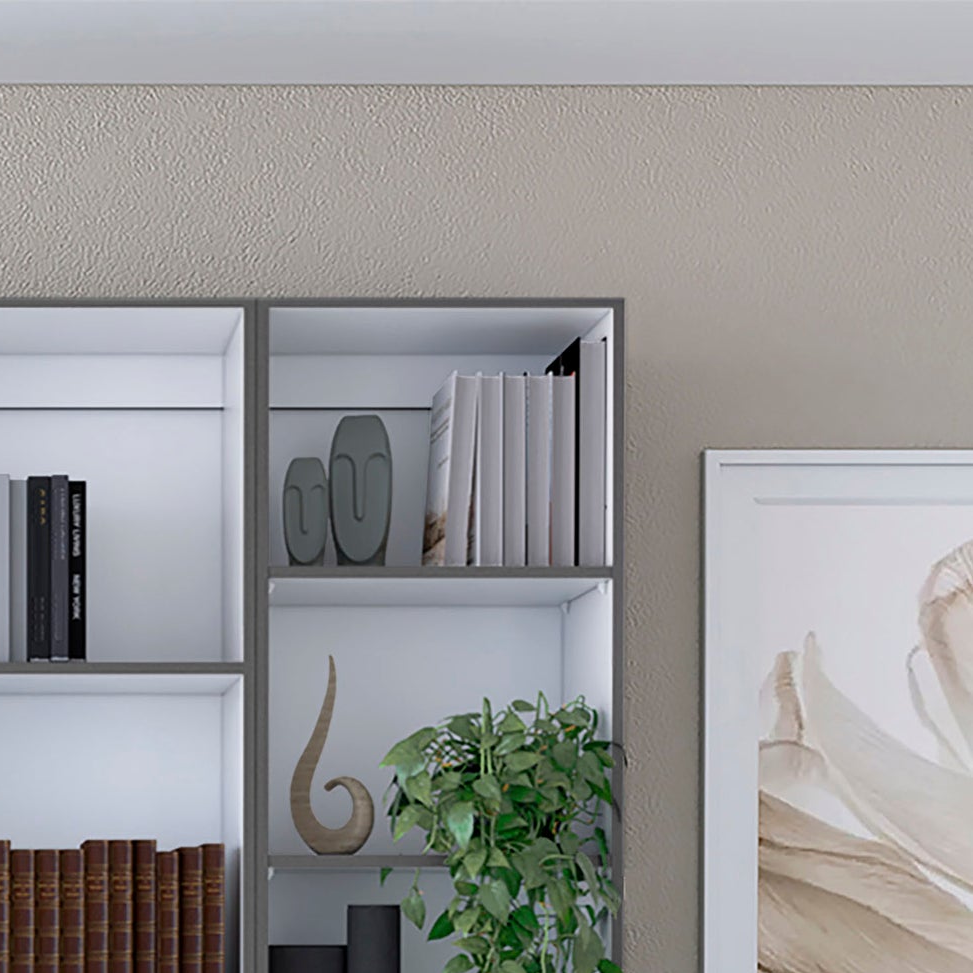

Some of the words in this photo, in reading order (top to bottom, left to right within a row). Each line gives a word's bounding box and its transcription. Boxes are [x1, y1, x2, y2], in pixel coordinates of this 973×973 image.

[72, 494, 80, 527] LUXURY
[72, 529, 80, 557] LIVING
[72, 574, 80, 594] NEW
[72, 596, 80, 620] YORK
